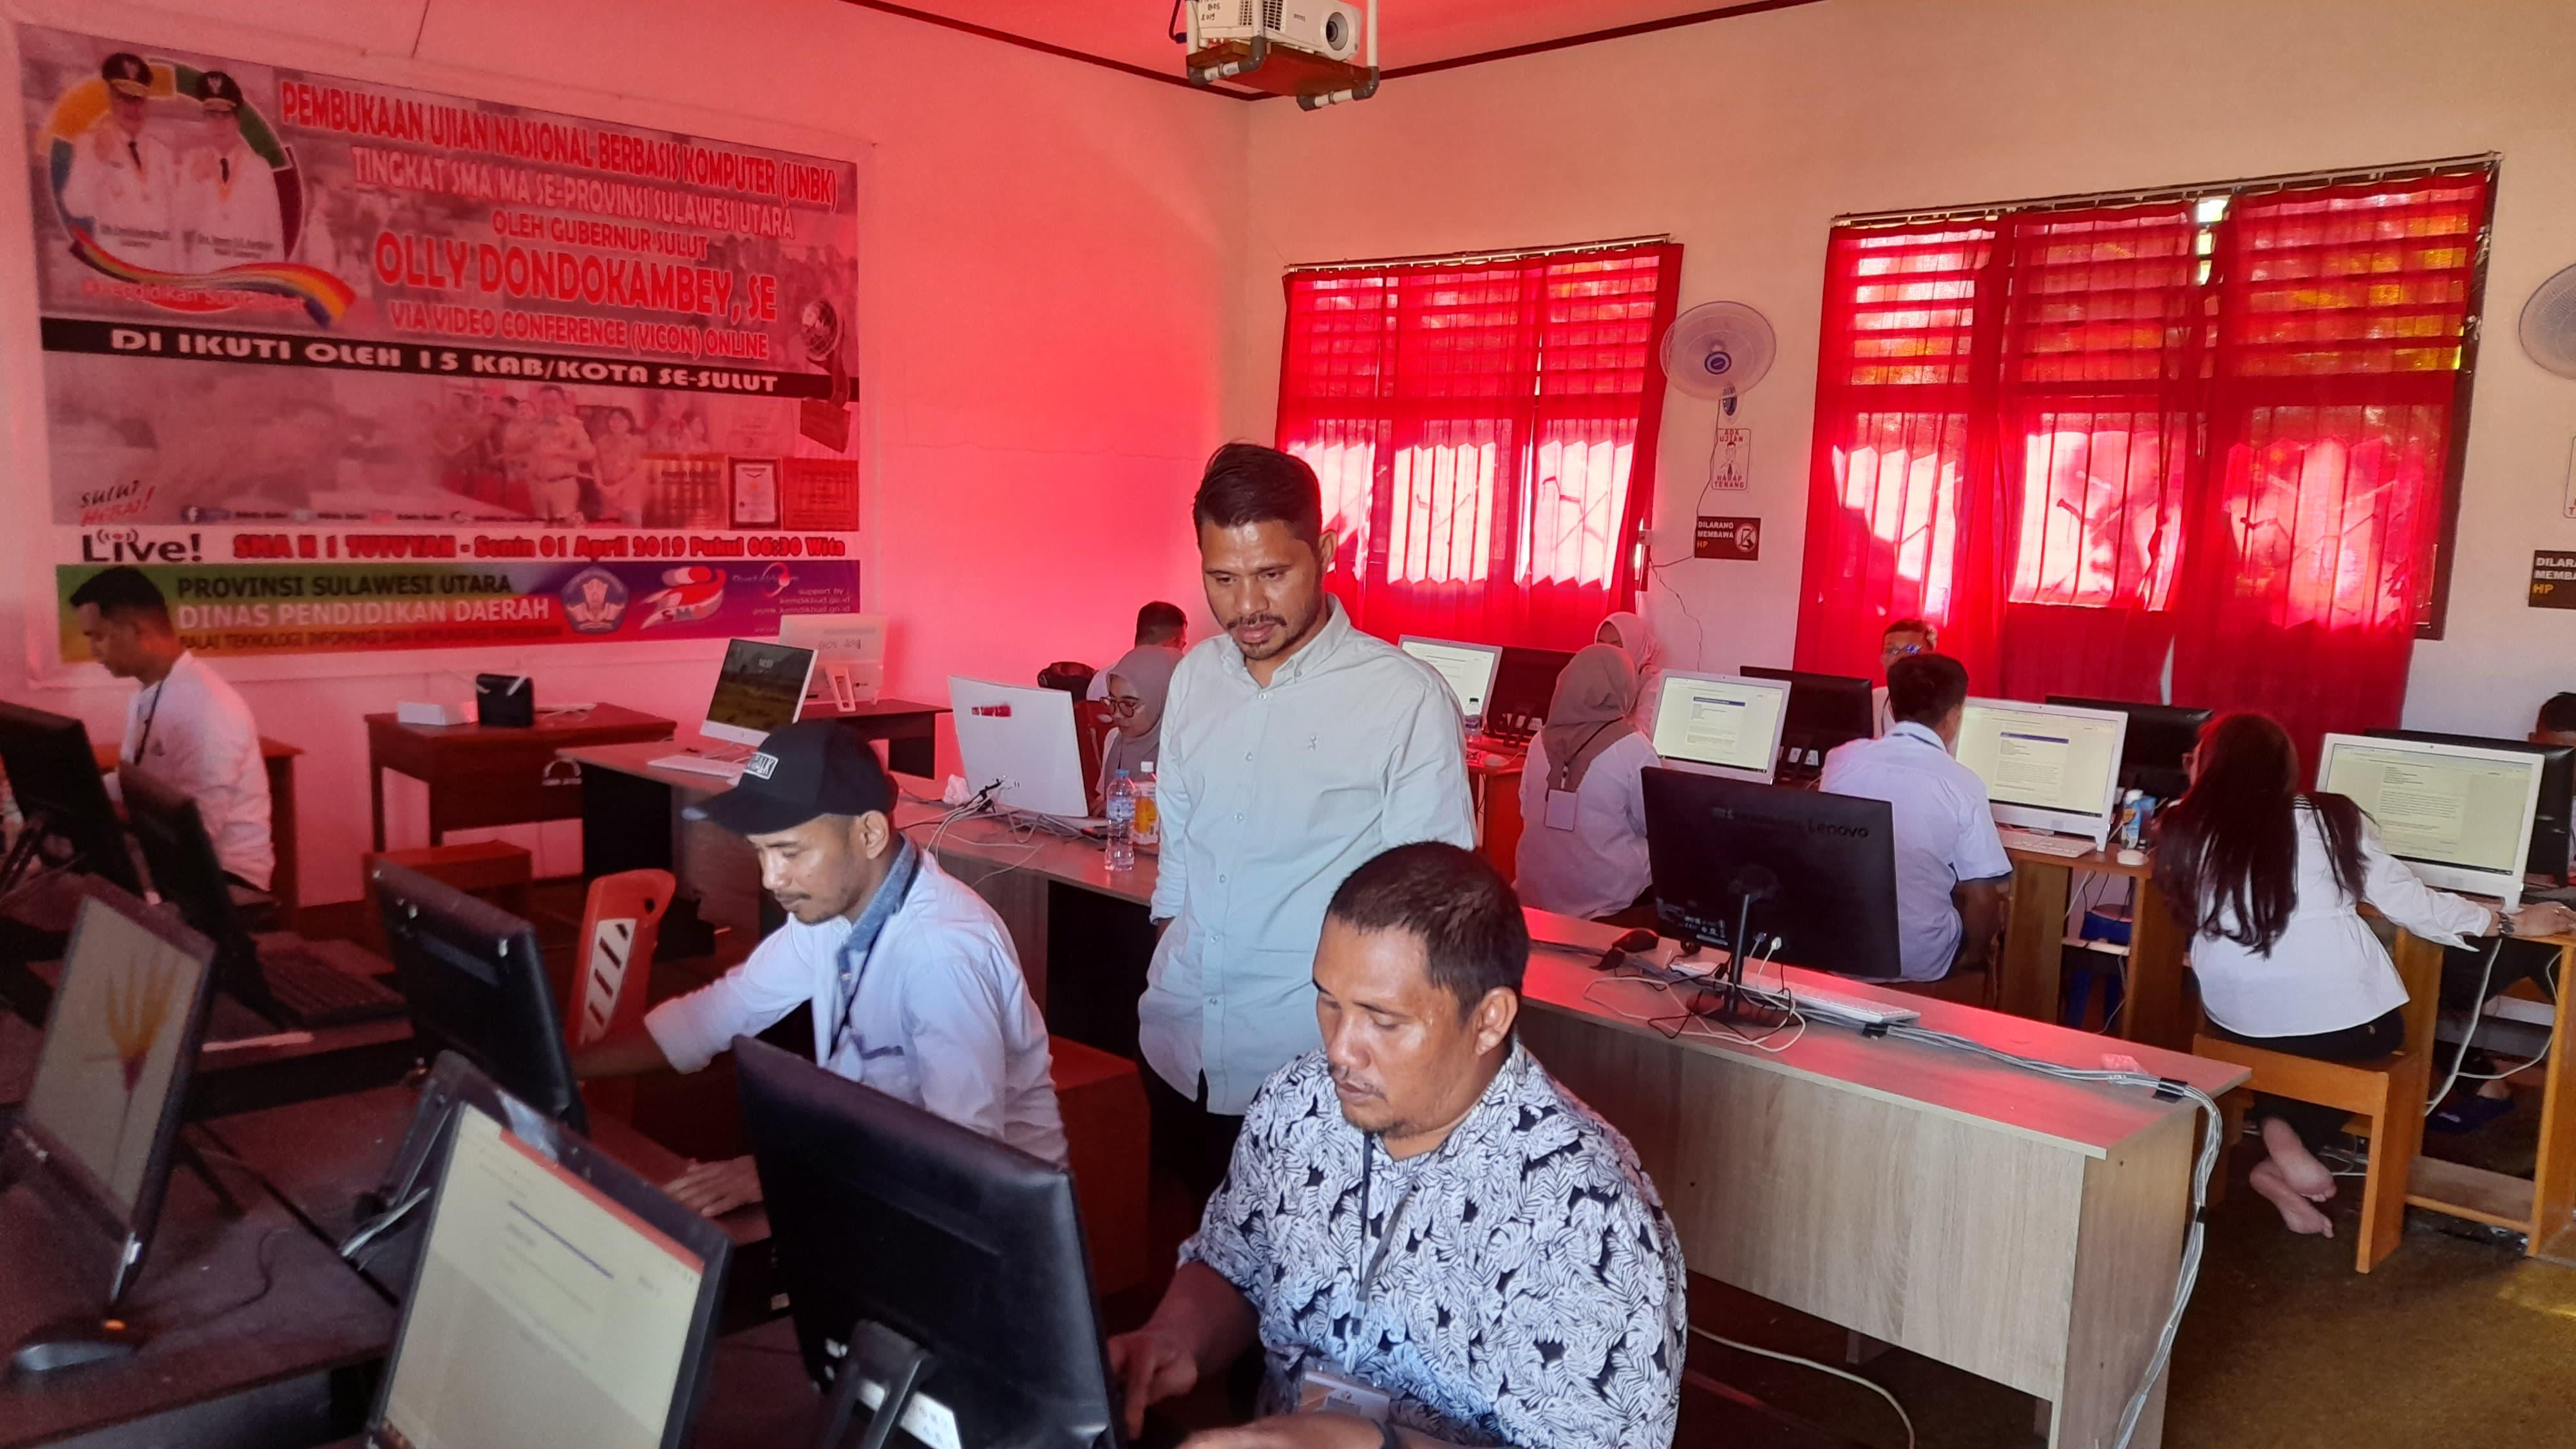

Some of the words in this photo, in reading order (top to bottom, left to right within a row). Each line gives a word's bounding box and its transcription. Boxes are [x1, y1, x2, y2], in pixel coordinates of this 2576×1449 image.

[282, 82, 424, 142] PEMBUKAAN
[430, 105, 489, 151] UJIAN
[494, 115, 593, 167] NASIONAL
[598, 133, 680, 181] BERBASIS
[681, 144, 777, 195] KOMPUTER
[781, 162, 836, 213] (UNBK)
[352, 146, 444, 191] TINGKAT
[537, 171, 652, 220] SE-PROVINSI
[654, 189, 736, 231] SULAWESI
[739, 202, 795, 240] UTARA
[492, 209, 545, 239] OLEH
[551, 218, 651, 253] GUBERNUR
[657, 231, 708, 260] SULUT
[375, 231, 468, 290] OLLY
[478, 243, 741, 325] DONDOKAMBEY,
[747, 274, 777, 321] SE
[390, 301, 428, 330] VIA
[432, 303, 497, 338] VIDEO
[501, 310, 627, 348] CONFERENCE
[631, 321, 701, 361] (VICON)
[706, 329, 770, 361] ONLINE
[110, 329, 162, 352] DI
[178, 334, 291, 360] IKUTI
[305, 343, 402, 368] OLEH
[419, 352, 459, 371] 15
[472, 354, 648, 383] KAB/KOTA
[657, 368, 778, 393] SE-SULUT
[82, 533, 202, 562] Live!
[474, 535, 536, 558] Senin
[539, 536, 567, 557] 01
[573, 535, 629, 562] April
[633, 536, 686, 557] 2019
[689, 536, 744, 557] Pukul
[805, 536, 846, 557] Wita
[1697, 530, 1734, 538] MEMBAWA
[1697, 540, 1709, 549] HP
[177, 576, 304, 598] PROVINSI
[313, 575, 433, 596] SULAWESI
[441, 574, 511, 594] UTARA
[2533, 583, 2555, 594] HP
[177, 604, 270, 629] DINAS
[278, 601, 447, 626] PENDIDIKAN
[454, 598, 549, 622] DAERAH
[1808, 819, 1869, 838] Lenovo
